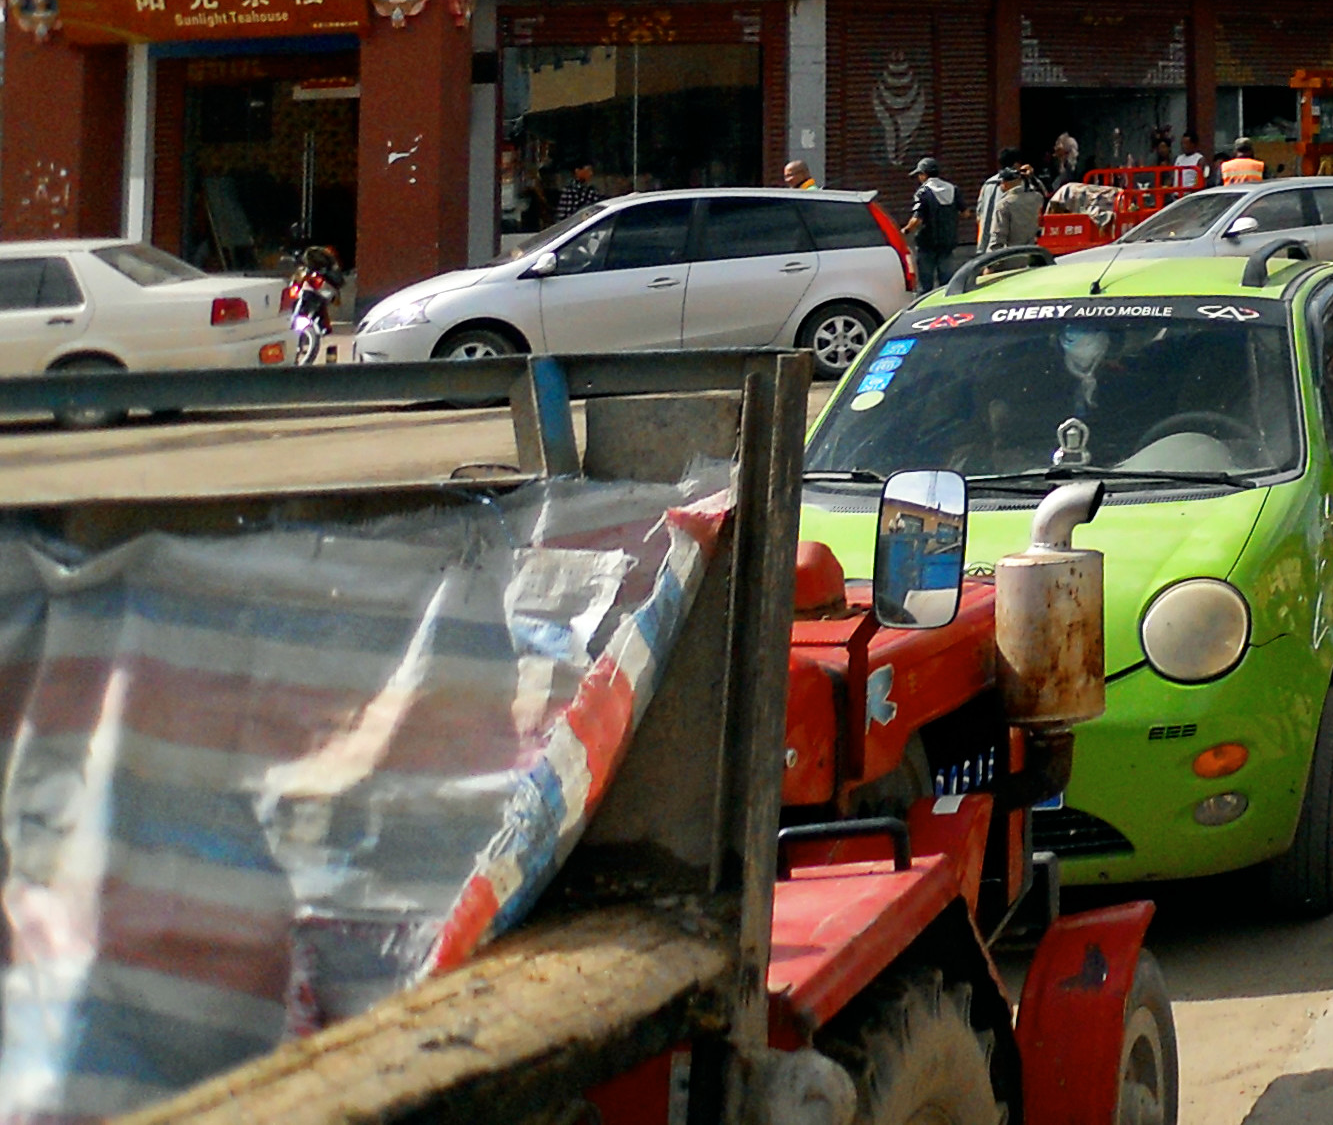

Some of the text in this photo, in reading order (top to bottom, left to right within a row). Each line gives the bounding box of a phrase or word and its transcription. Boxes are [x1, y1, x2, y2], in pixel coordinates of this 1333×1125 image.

[175, 11, 289, 28] Sunlight Teahouse
[991, 304, 1173, 323] CHERY AUTO MOBILE
